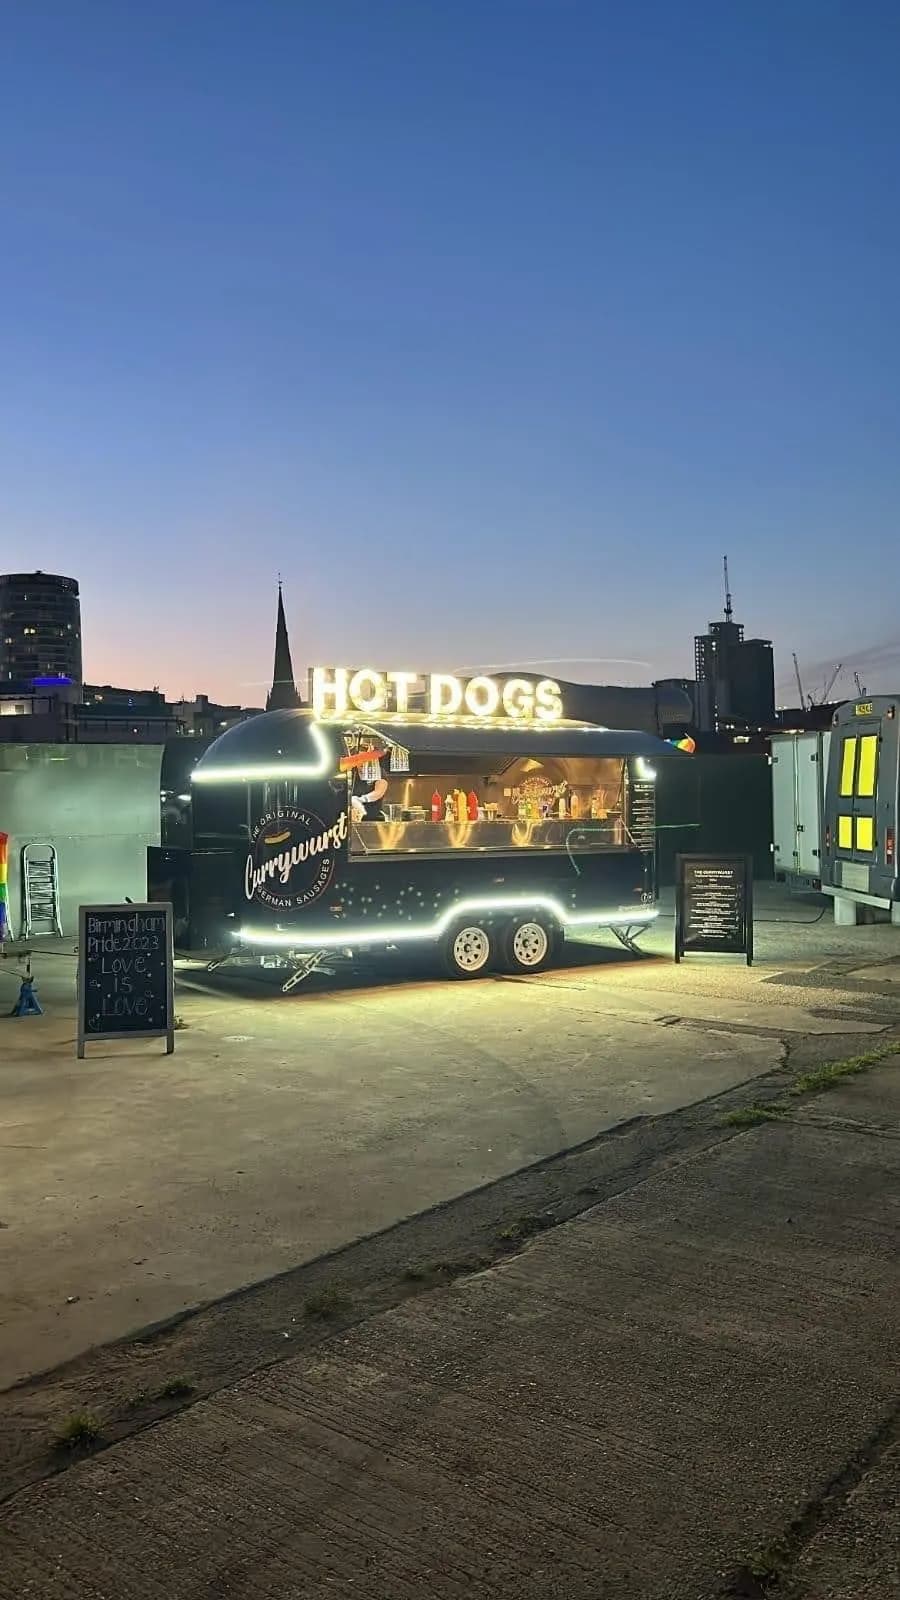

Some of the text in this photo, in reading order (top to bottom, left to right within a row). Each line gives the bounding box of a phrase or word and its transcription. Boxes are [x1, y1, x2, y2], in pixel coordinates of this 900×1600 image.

[312, 668, 563, 720] HOT DOGS
[260, 810, 313, 825] ORIGINAL
[245, 812, 348, 900] Currywurst
[257, 858, 330, 907] GERMAN SAUSAGES
[88, 913, 165, 938] Birmingham
